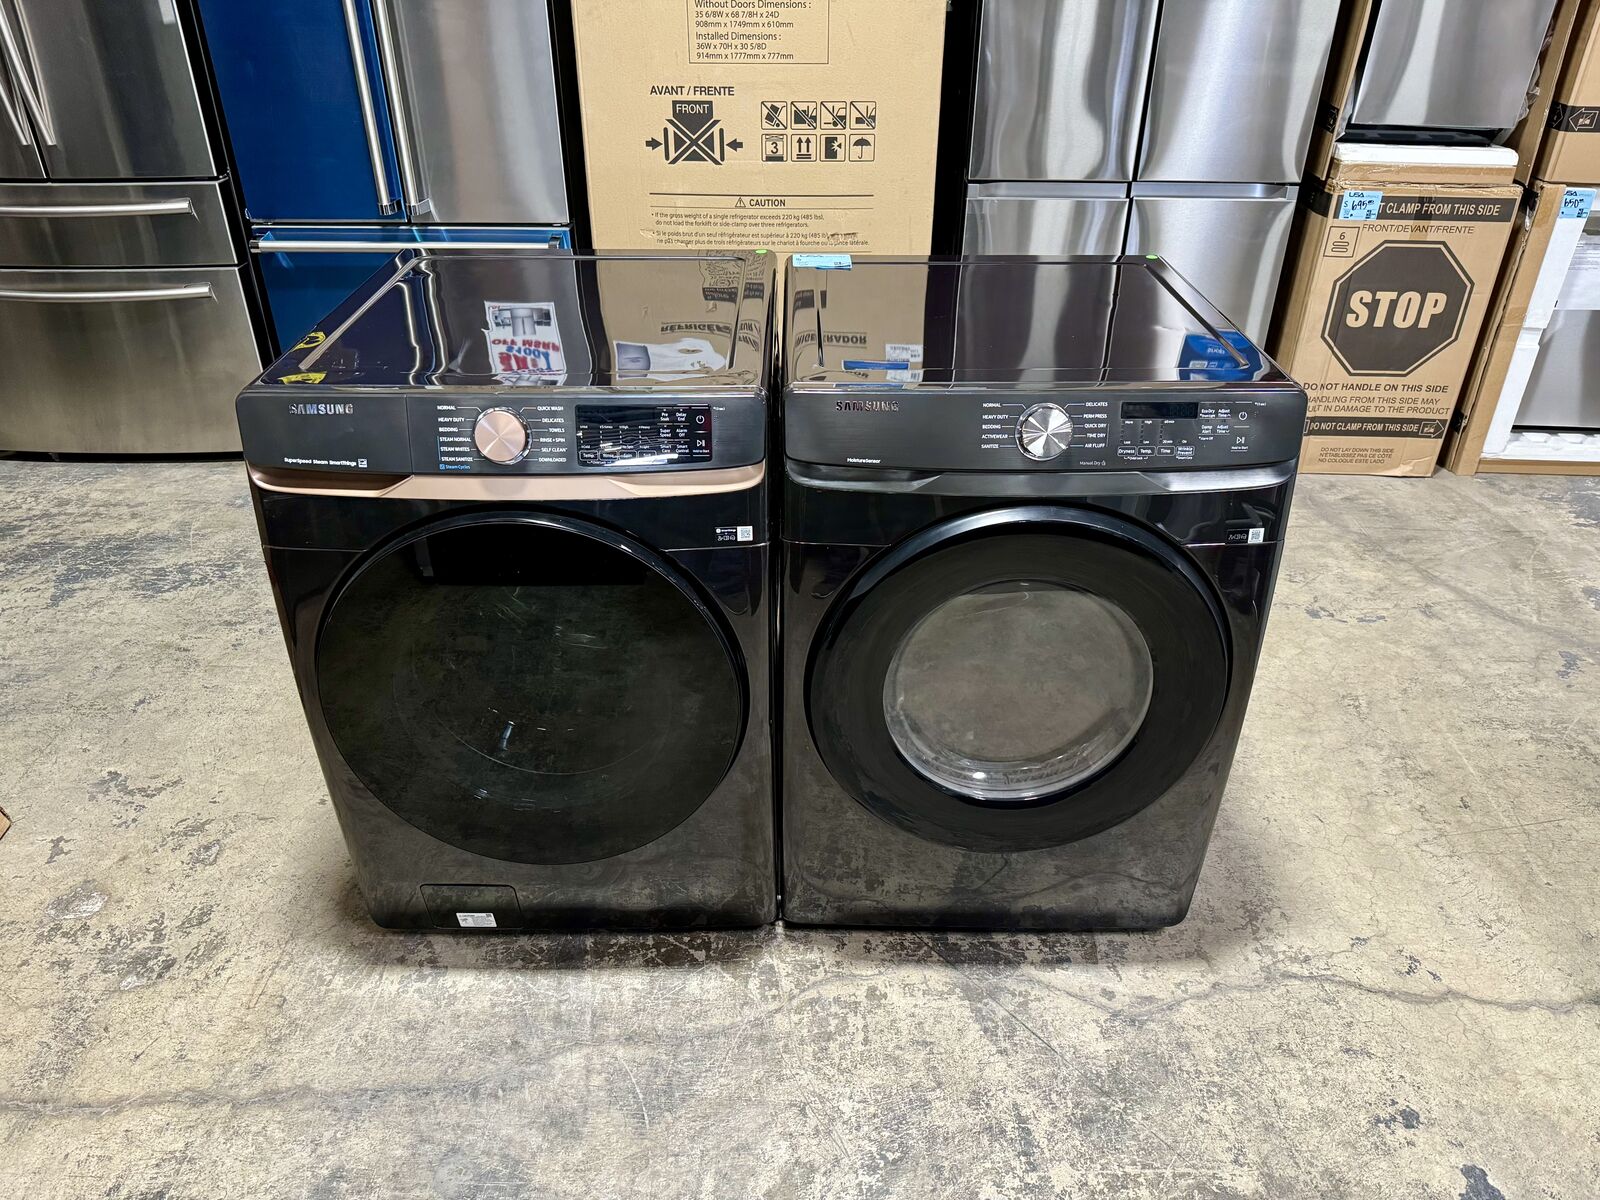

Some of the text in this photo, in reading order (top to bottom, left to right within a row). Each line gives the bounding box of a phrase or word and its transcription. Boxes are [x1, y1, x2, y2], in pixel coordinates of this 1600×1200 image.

[694, 0, 806, 9] Without Doors Dimensions
[695, 11, 780, 19] 35 6/8W 68 7/8H 24D
[695, 21, 794, 29] 908mm 1749mm 610mm
[696, 32, 777, 41] Installed Dimensions
[749, 43, 767, 51] 5/8D
[650, 86, 735, 96] AVANT FRENTE
[676, 104, 710, 114] FRONT
[771, 142, 779, 154] 3
[749, 199, 786, 207] CAUTION
[1352, 200, 1368, 211] 695
[1387, 202, 1421, 216] CLAMP
[1422, 203, 1451, 215] FROM
[1454, 204, 1475, 216] THIS
[1477, 204, 1501, 217] SIDE
[1362, 224, 1475, 235] FRONT/DEVANT/FRENTE
[1339, 232, 1346, 240] 6
[1346, 290, 1447, 329] STOP
[1303, 382, 1449, 393] DO NOT HANDLE ON THIS SIDE
[1349, 396, 1377, 404] FROM
[1399, 397, 1419, 405] SIDE
[288, 404, 354, 415] SAMSUNG
[836, 401, 899, 412] SAMSUNG
[1334, 405, 1372, 413] DAMAGE
[1388, 406, 1405, 414] THE
[1406, 407, 1450, 415] PRODUCT
[1310, 422, 1419, 432] DO NOT CLAMP FROM THIS SIDE
